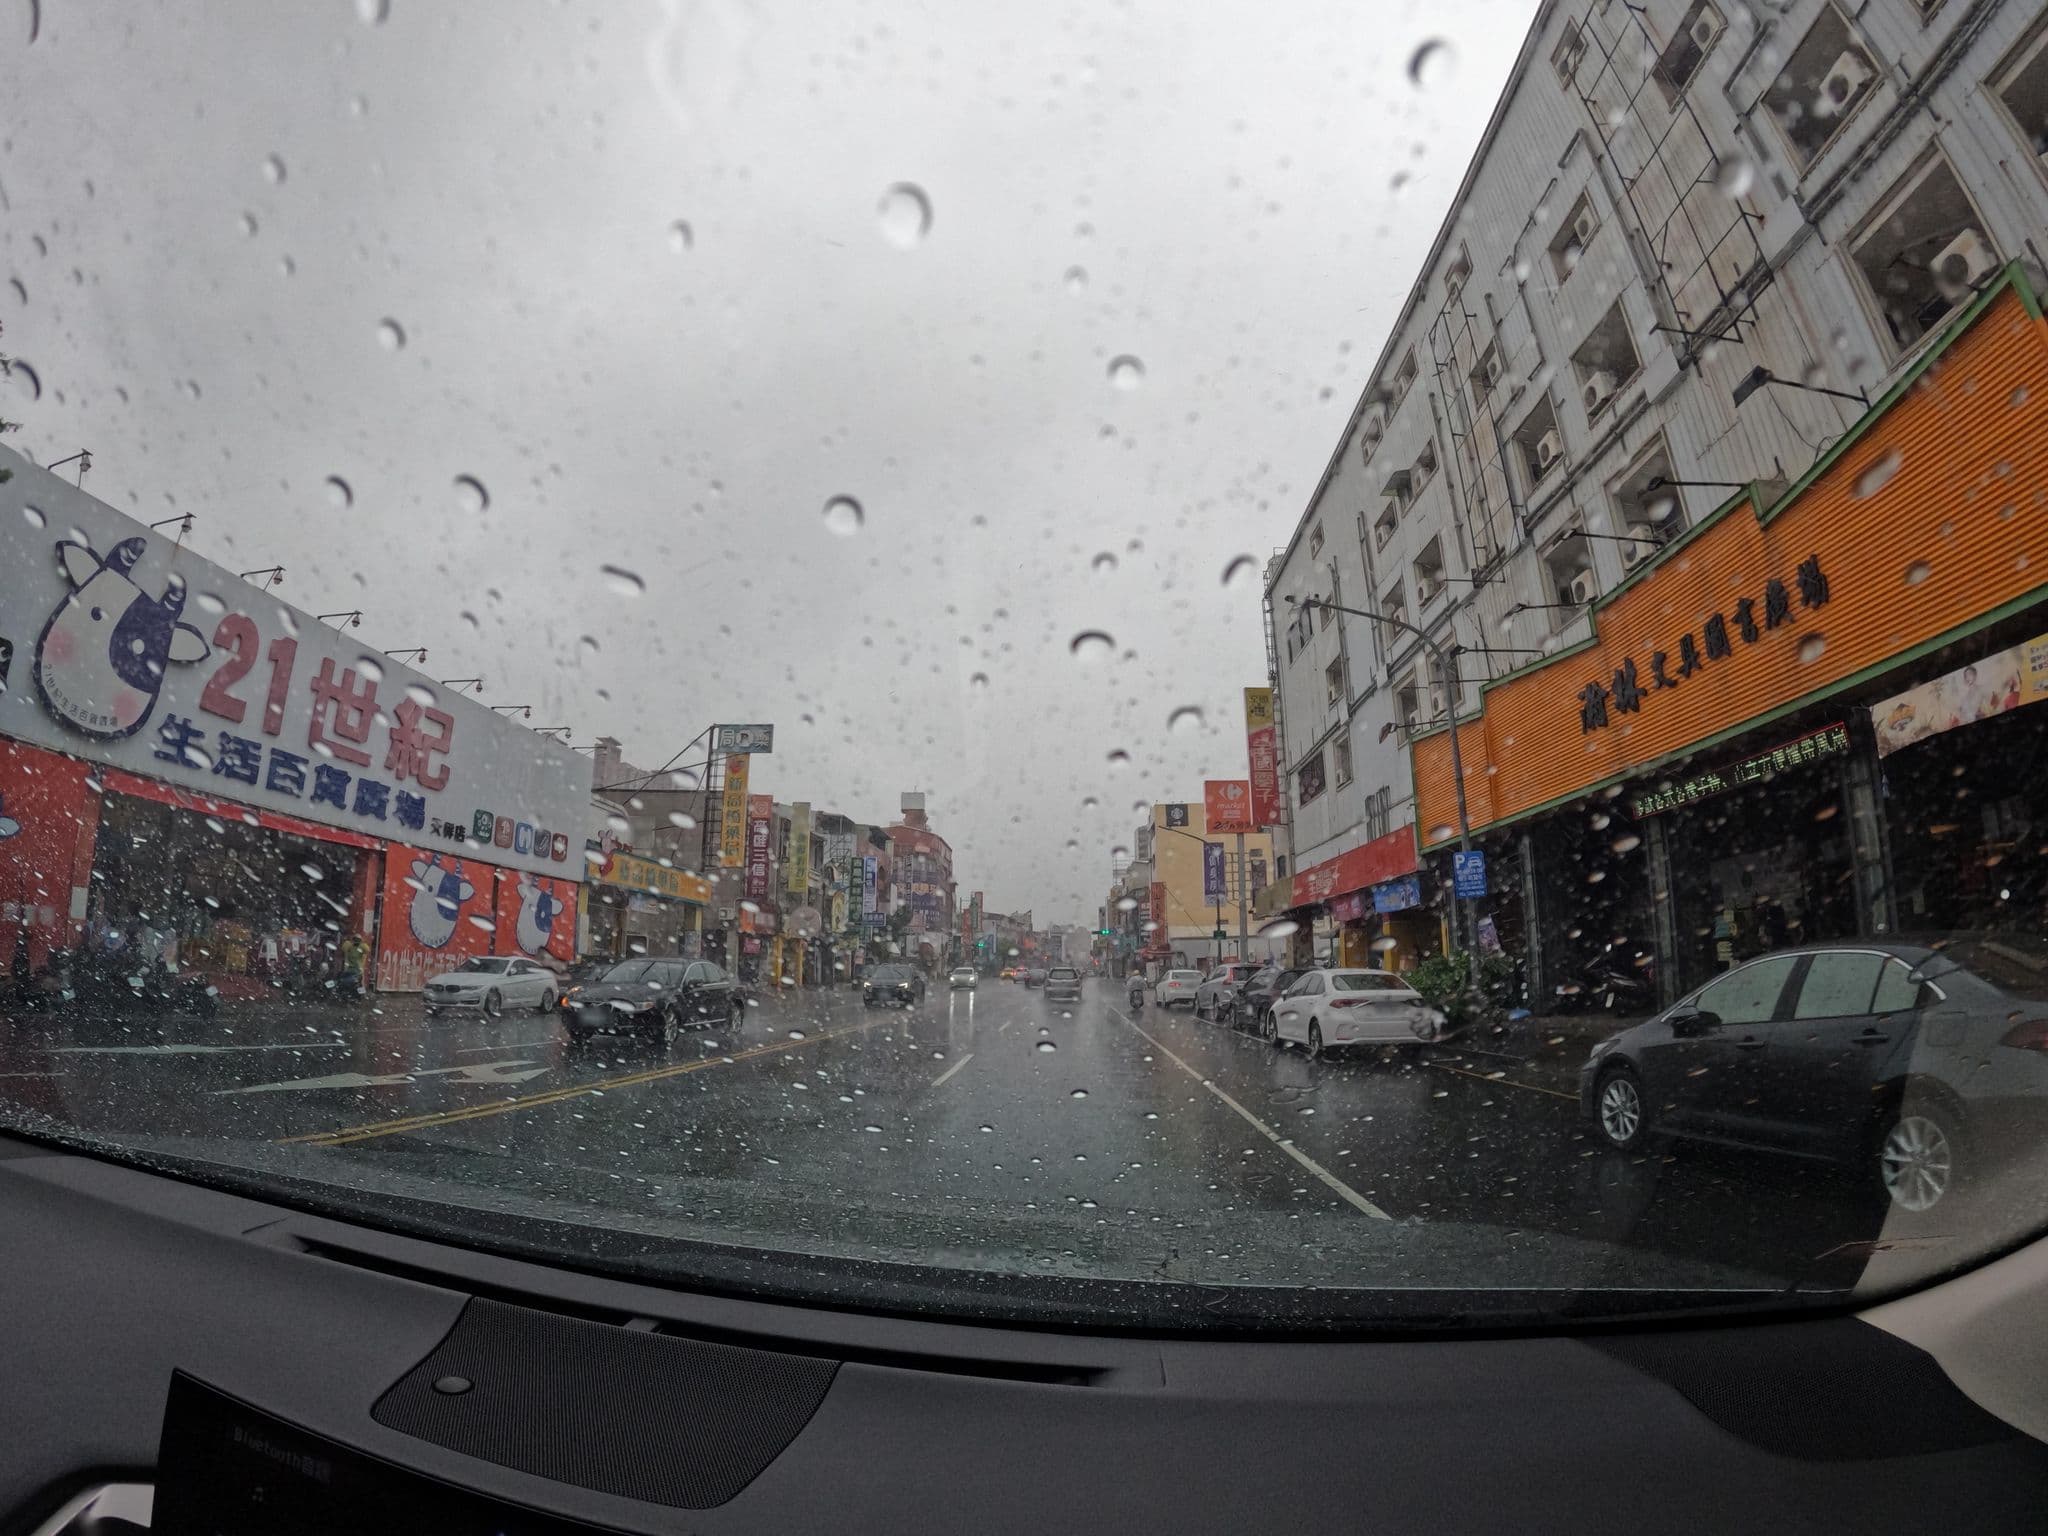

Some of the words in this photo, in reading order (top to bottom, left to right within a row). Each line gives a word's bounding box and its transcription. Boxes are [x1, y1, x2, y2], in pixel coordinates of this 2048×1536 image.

[200, 612, 454, 791] 21世紀
[154, 713, 426, 830] 生活百貨廣場
[1455, 855, 1465, 869] P
